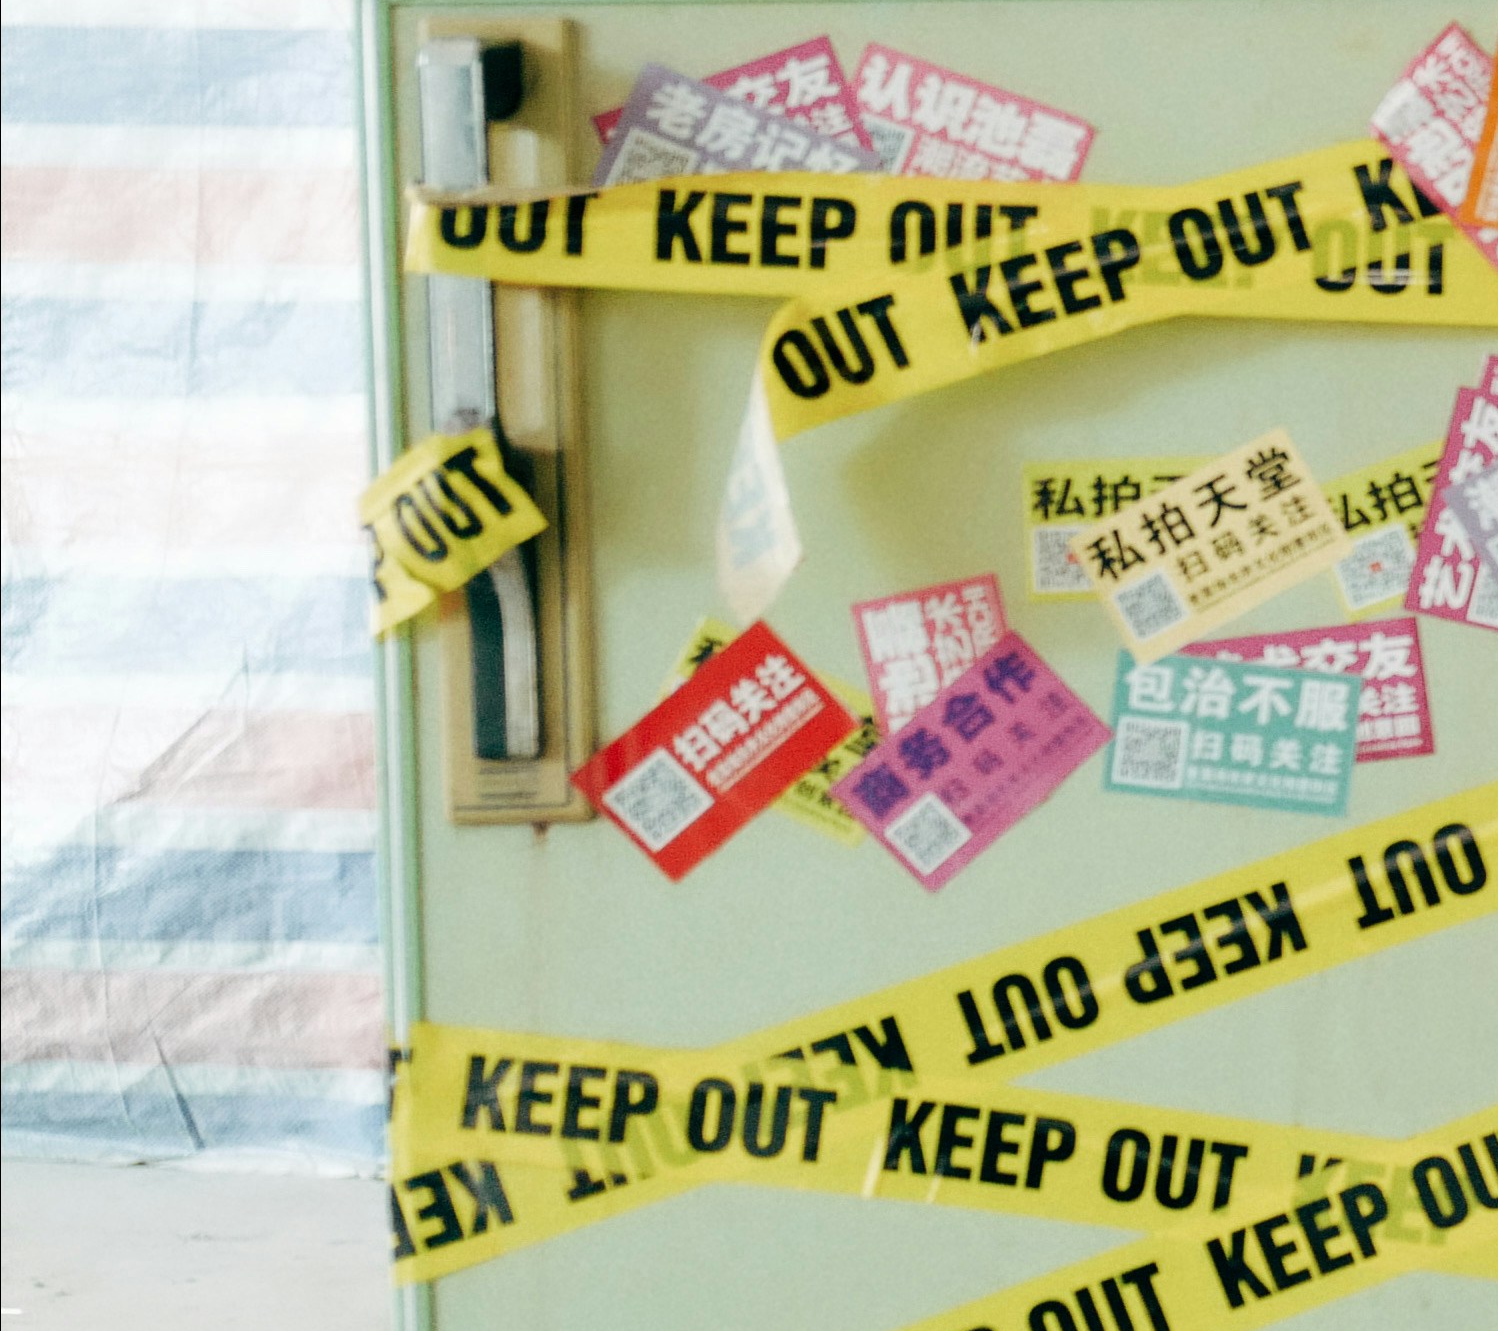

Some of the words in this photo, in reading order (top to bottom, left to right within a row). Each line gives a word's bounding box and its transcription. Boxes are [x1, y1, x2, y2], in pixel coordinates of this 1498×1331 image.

[857, 54, 1087, 180] 认识池磊
[438, 191, 598, 257] OUT
[656, 189, 857, 269] KEEP
[772, 294, 910, 400] OUT
[948, 228, 1142, 345] KEEP
[1169, 180, 1313, 282] OUT
[394, 445, 514, 564] OUT
[1085, 445, 1301, 582] 私拍天堂
[1175, 494, 1312, 583] 扫码关注
[672, 653, 806, 773] 扫码关注
[1126, 664, 1351, 731] 包治不服
[1190, 730, 1345, 776] 扫码关注
[1346, 822, 1489, 930] OUT
[1122, 880, 1309, 1006] KEEP
[955, 955, 1100, 1067] OUT
[460, 1053, 660, 1144] KEEP
[685, 1077, 840, 1163] OUT
[881, 1095, 1077, 1190] KEEP
[1100, 1126, 1249, 1214] OUT
[1206, 1181, 1389, 1310] KEEP
